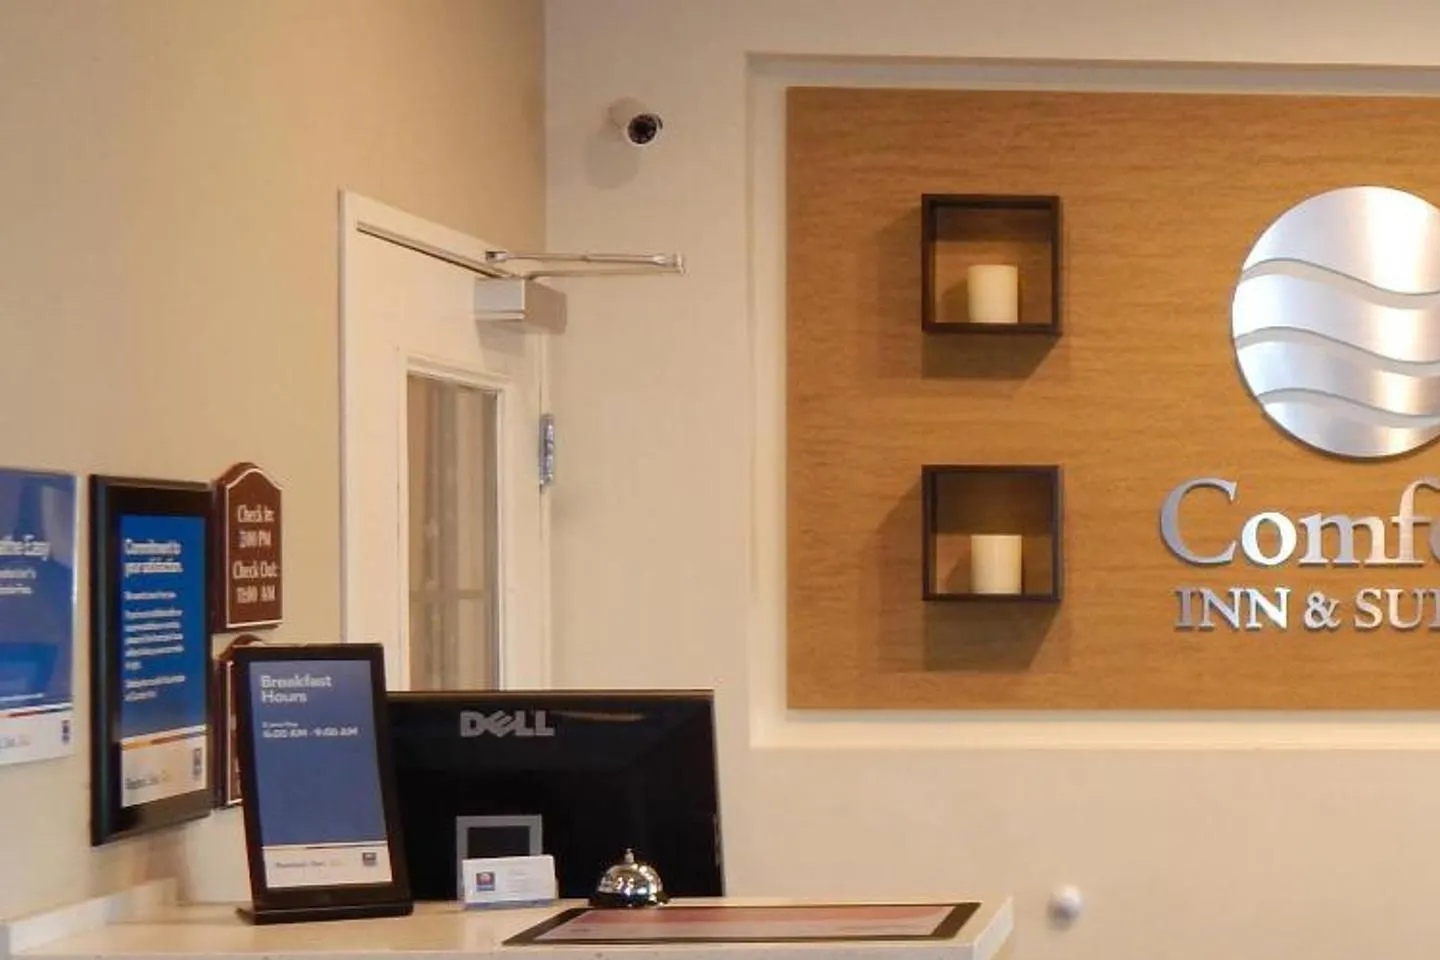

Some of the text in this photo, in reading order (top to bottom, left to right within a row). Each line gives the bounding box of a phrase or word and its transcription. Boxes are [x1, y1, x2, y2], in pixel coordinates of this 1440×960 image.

[237, 504, 262, 523] Check
[258, 529, 272, 547] PM
[232, 560, 259, 579] Check
[260, 584, 276, 603] AM
[1174, 587, 1291, 632] INN
[1304, 590, 1342, 631] &
[261, 674, 332, 689] Breakfast
[261, 689, 307, 703] Hours
[460, 709, 555, 738] DELL
